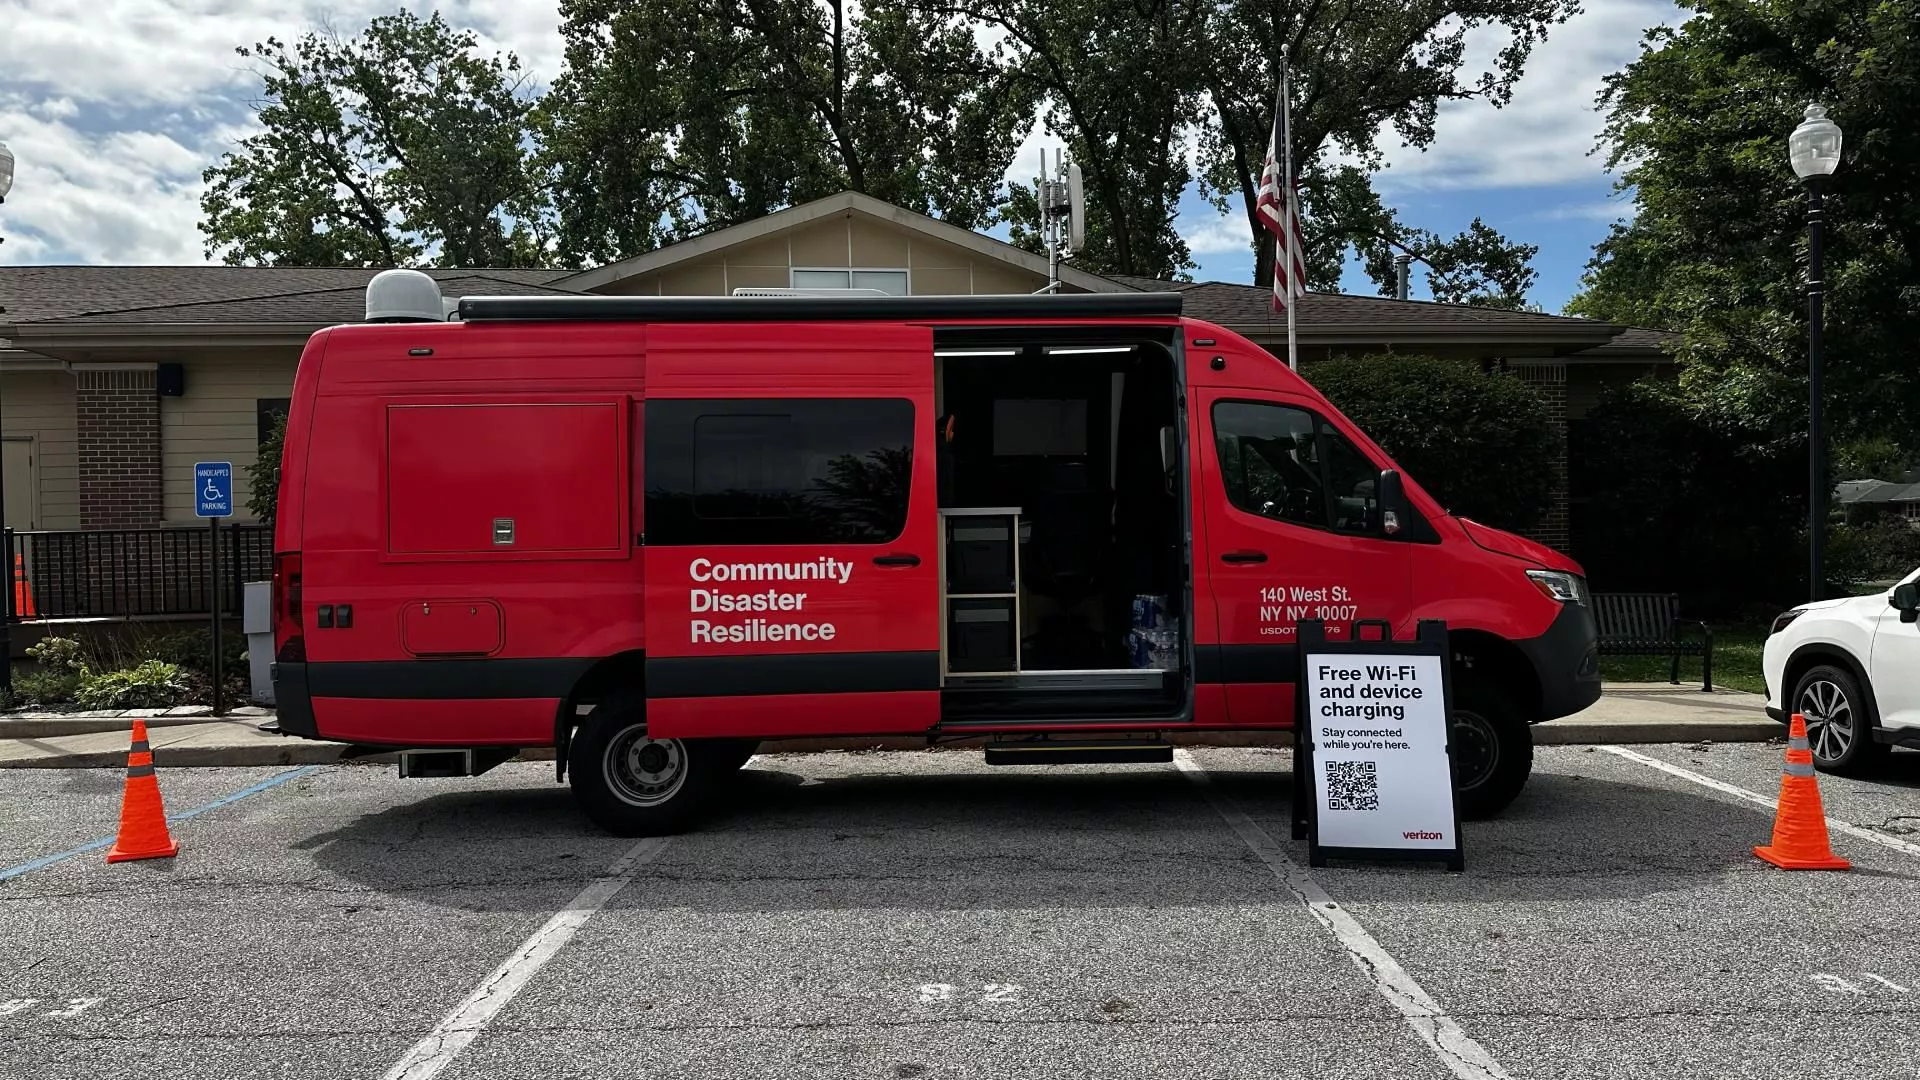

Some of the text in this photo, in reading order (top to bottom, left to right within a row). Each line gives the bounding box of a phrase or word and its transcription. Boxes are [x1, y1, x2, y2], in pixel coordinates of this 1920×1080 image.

[197, 469, 229, 477] HANDICAPPED
[202, 502, 227, 510] PARKING
[689, 556, 854, 584] Community
[690, 589, 807, 613] Disaster
[1260, 585, 1352, 603] 140 West St.
[1260, 605, 1358, 622] NY NY 10007
[691, 618, 836, 644] Resilience
[1260, 626, 1297, 635] USDOT
[1318, 665, 1416, 681] Free Wi-Fi
[1319, 684, 1423, 699] and device
[1320, 702, 1405, 720] charging
[1322, 727, 1402, 738] Stay connected
[1323, 740, 1411, 750] while you're here.
[1402, 830, 1443, 841] verizon
